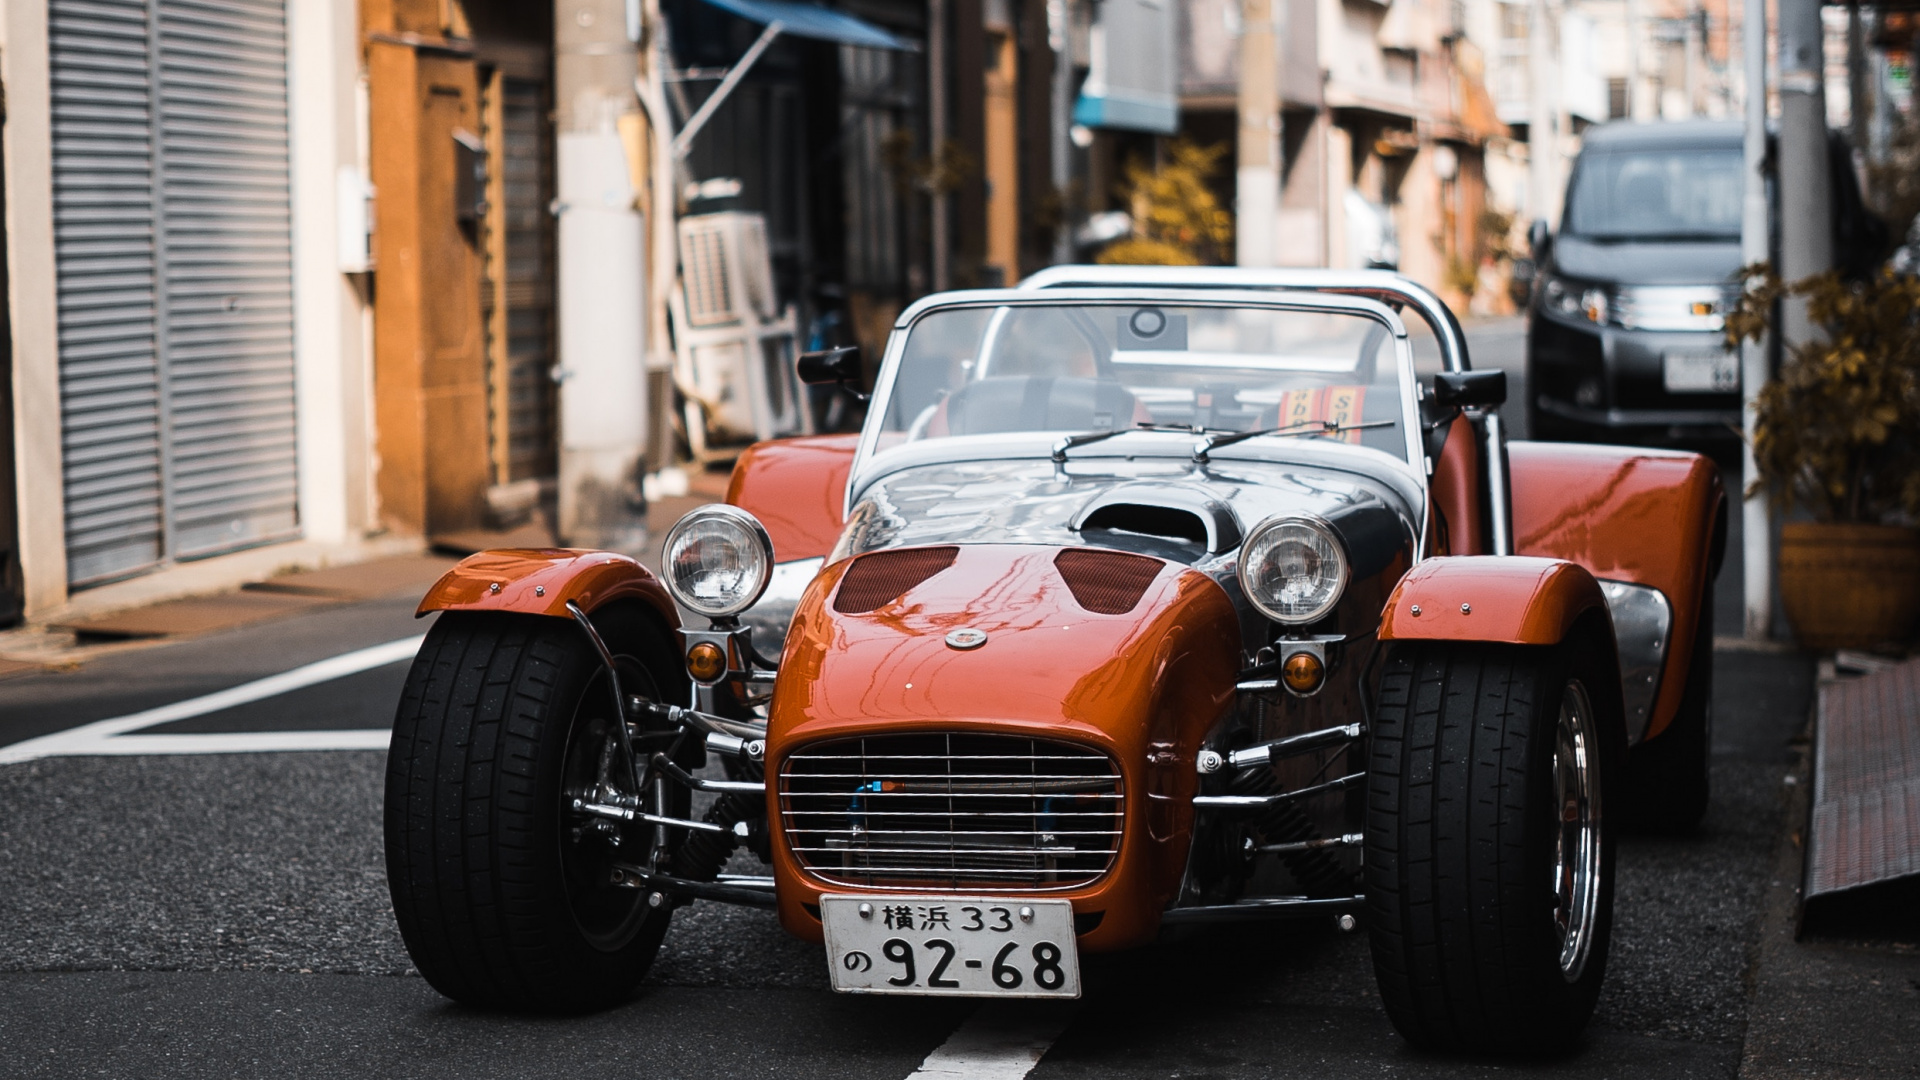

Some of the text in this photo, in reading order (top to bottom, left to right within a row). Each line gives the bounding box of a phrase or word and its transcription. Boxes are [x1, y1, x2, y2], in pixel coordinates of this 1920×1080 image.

[882, 905, 1013, 932] 横浜 33
[843, 937, 1065, 990] の 92-68
